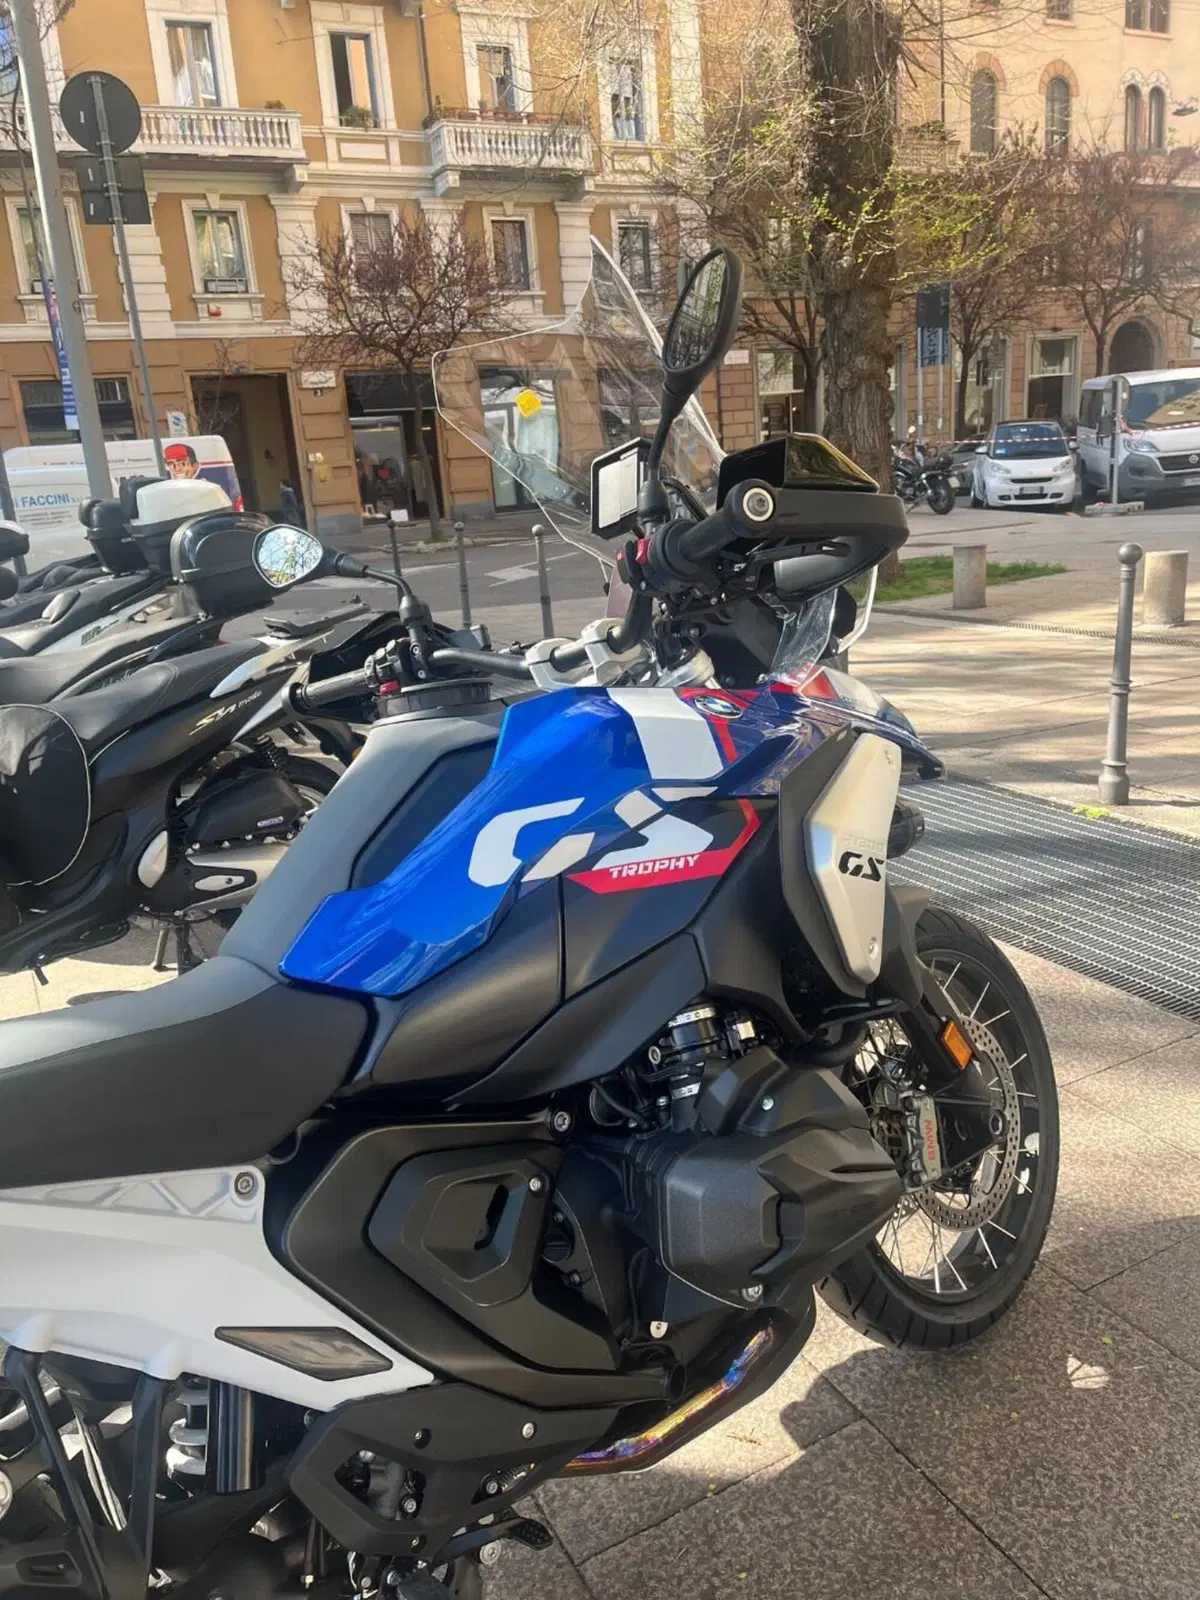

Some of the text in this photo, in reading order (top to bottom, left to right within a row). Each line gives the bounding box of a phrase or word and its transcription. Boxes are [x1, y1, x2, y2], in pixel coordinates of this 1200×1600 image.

[21, 493, 70, 508] FACCINI
[467, 786, 719, 887] GS
[608, 854, 700, 879] TROPHY
[838, 850, 885, 882] GS
[923, 1119, 936, 1161] BMW
